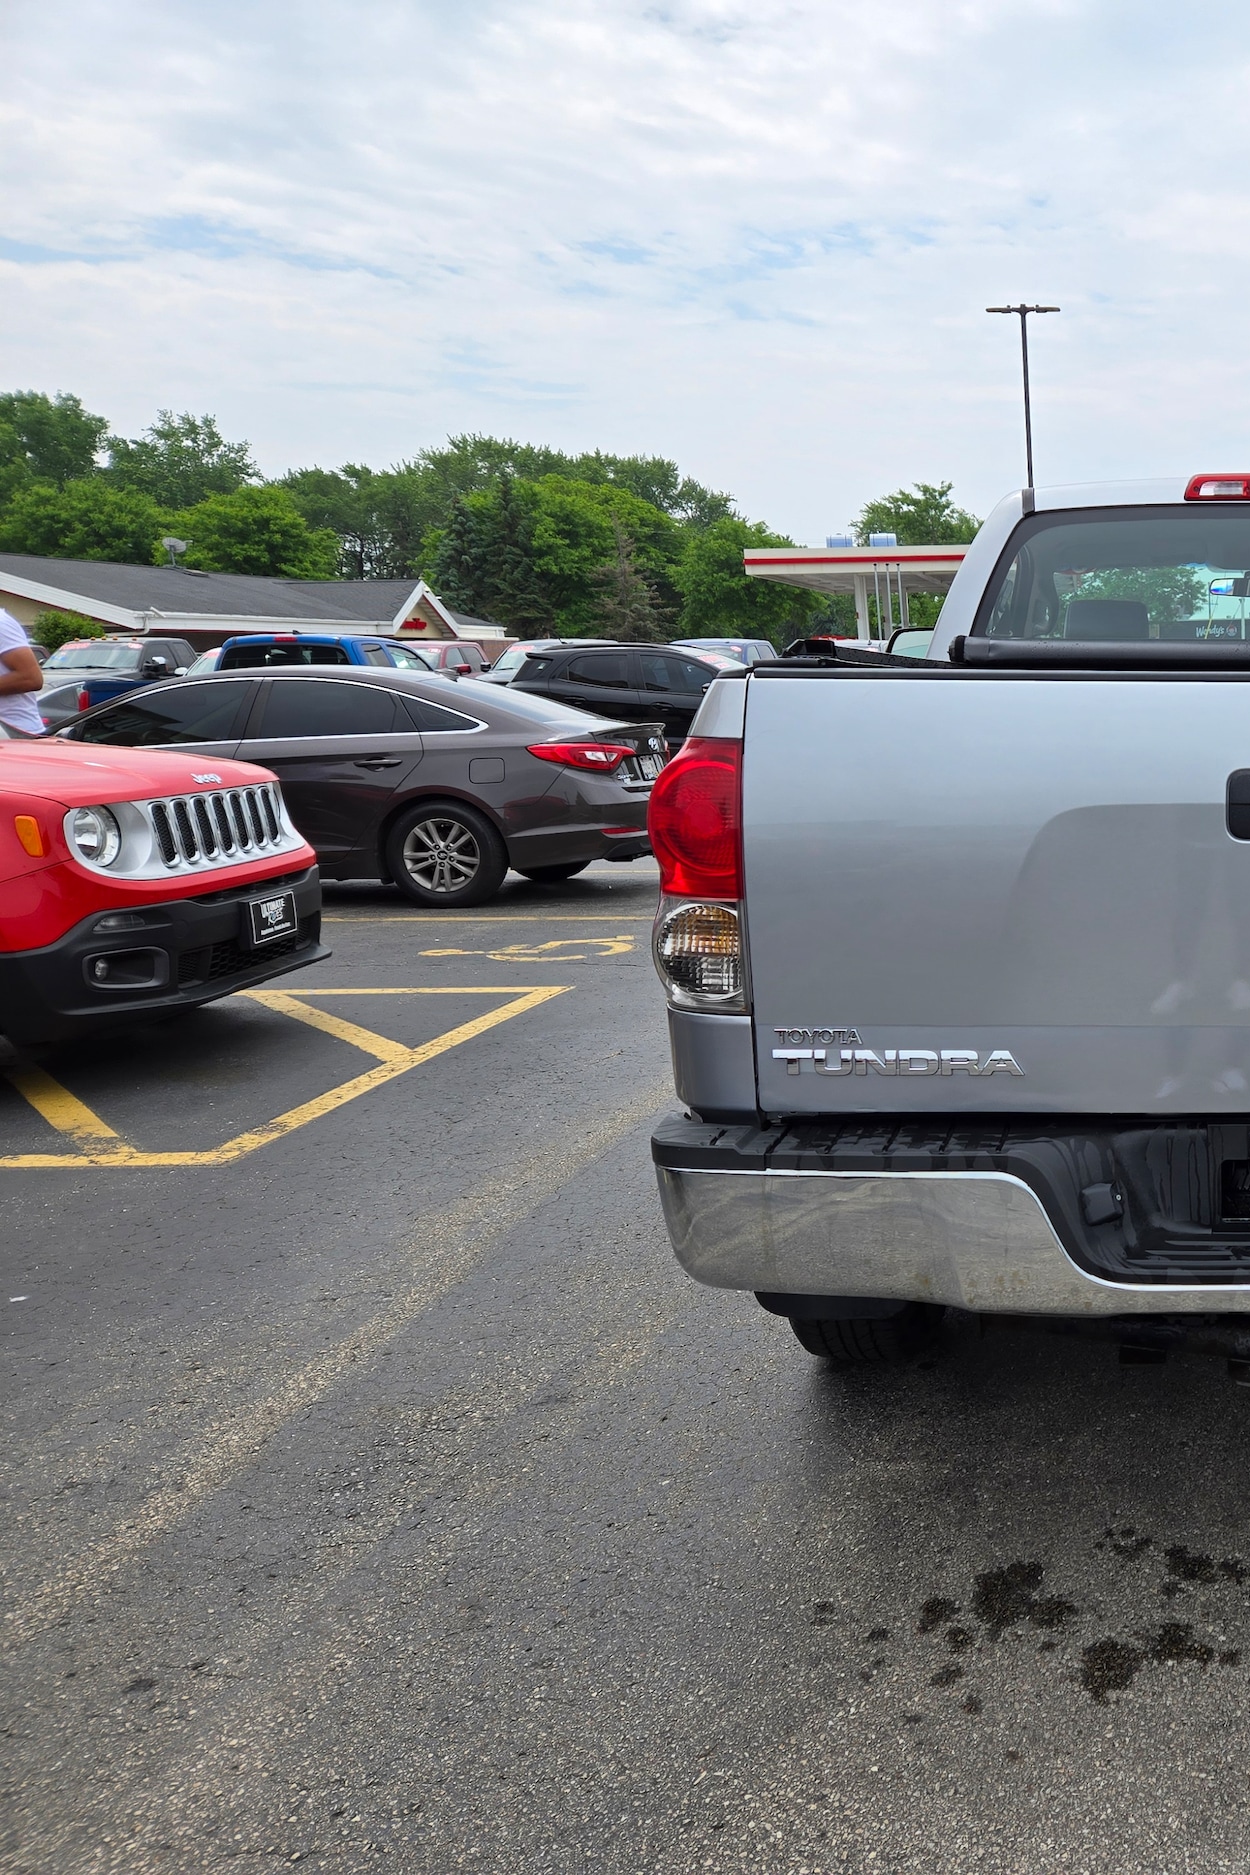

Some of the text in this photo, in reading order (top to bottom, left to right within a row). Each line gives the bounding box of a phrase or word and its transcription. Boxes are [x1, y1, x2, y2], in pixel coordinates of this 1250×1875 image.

[190, 773, 223, 784] Jeep
[774, 1028, 863, 1045] TOYOTA
[772, 1049, 1026, 1076] TUNDRA
